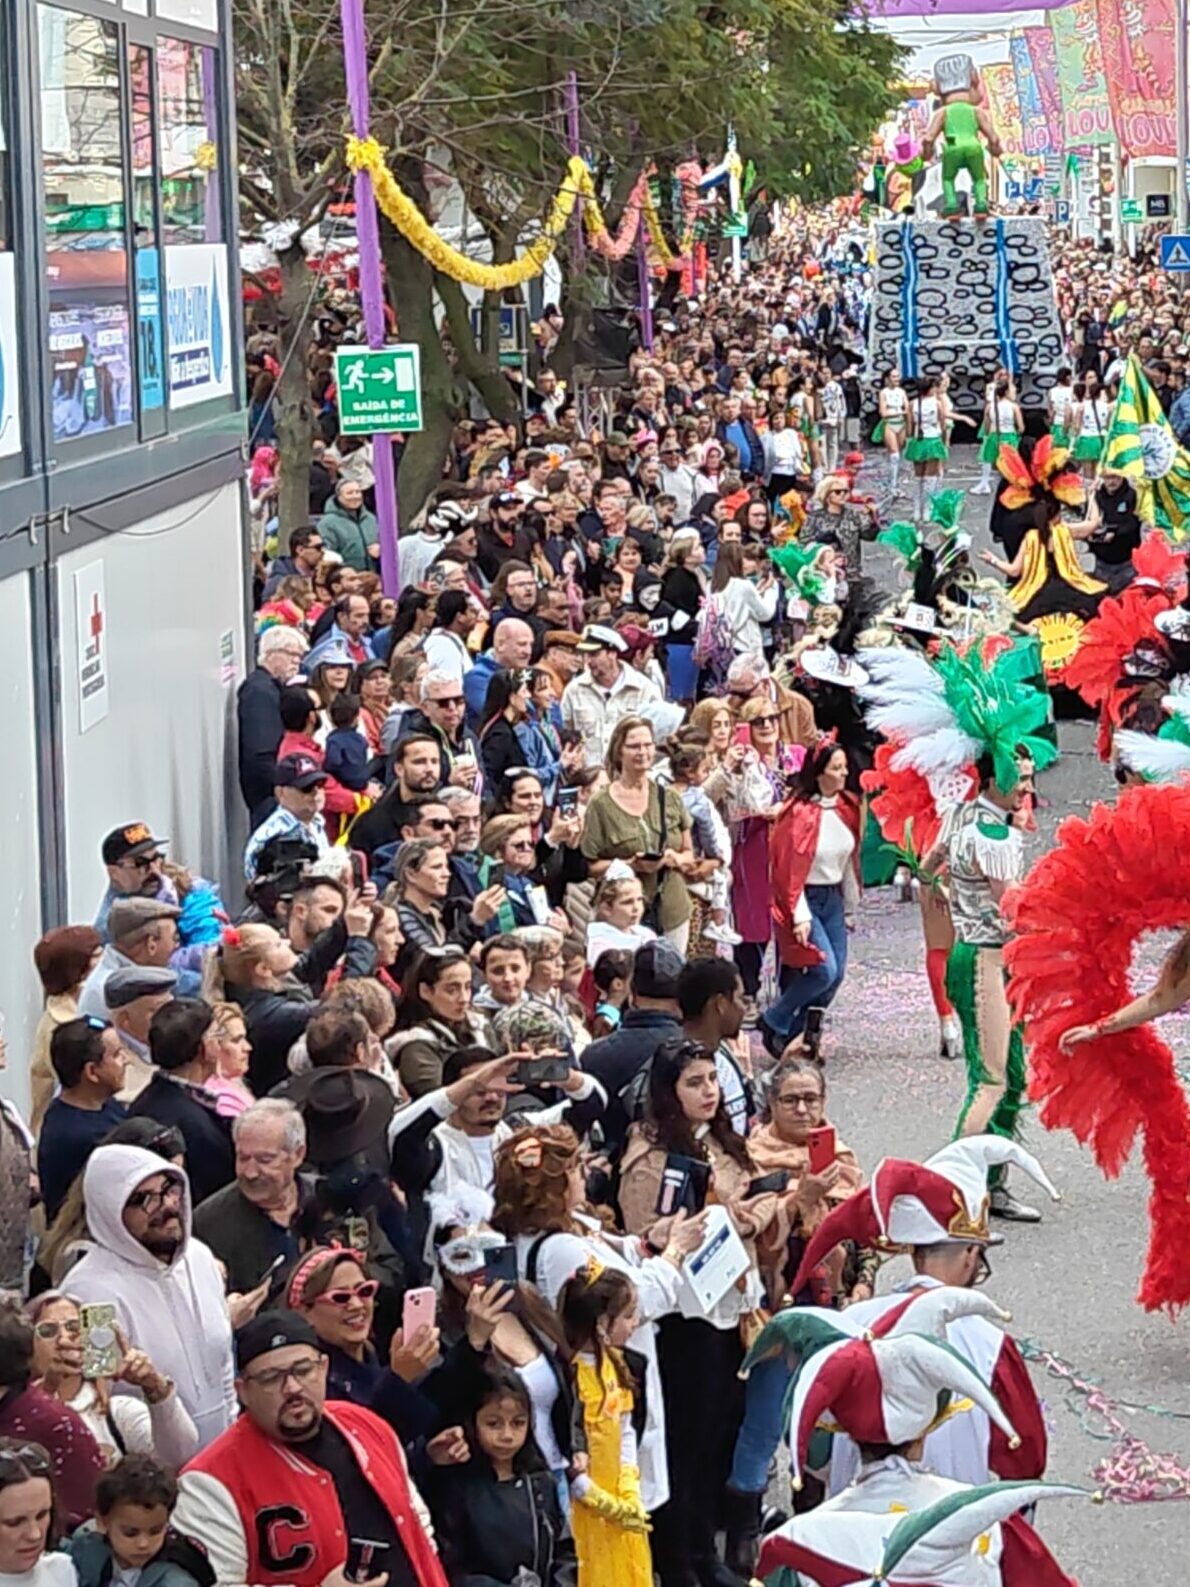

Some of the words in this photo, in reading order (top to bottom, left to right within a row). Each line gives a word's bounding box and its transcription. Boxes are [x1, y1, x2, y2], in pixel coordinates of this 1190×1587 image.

[352, 399, 389, 411] SAÍDA
[390, 399, 406, 409] DE
[343, 412, 419, 425] EMERGÊNCIA
[255, 1504, 316, 1575] C
